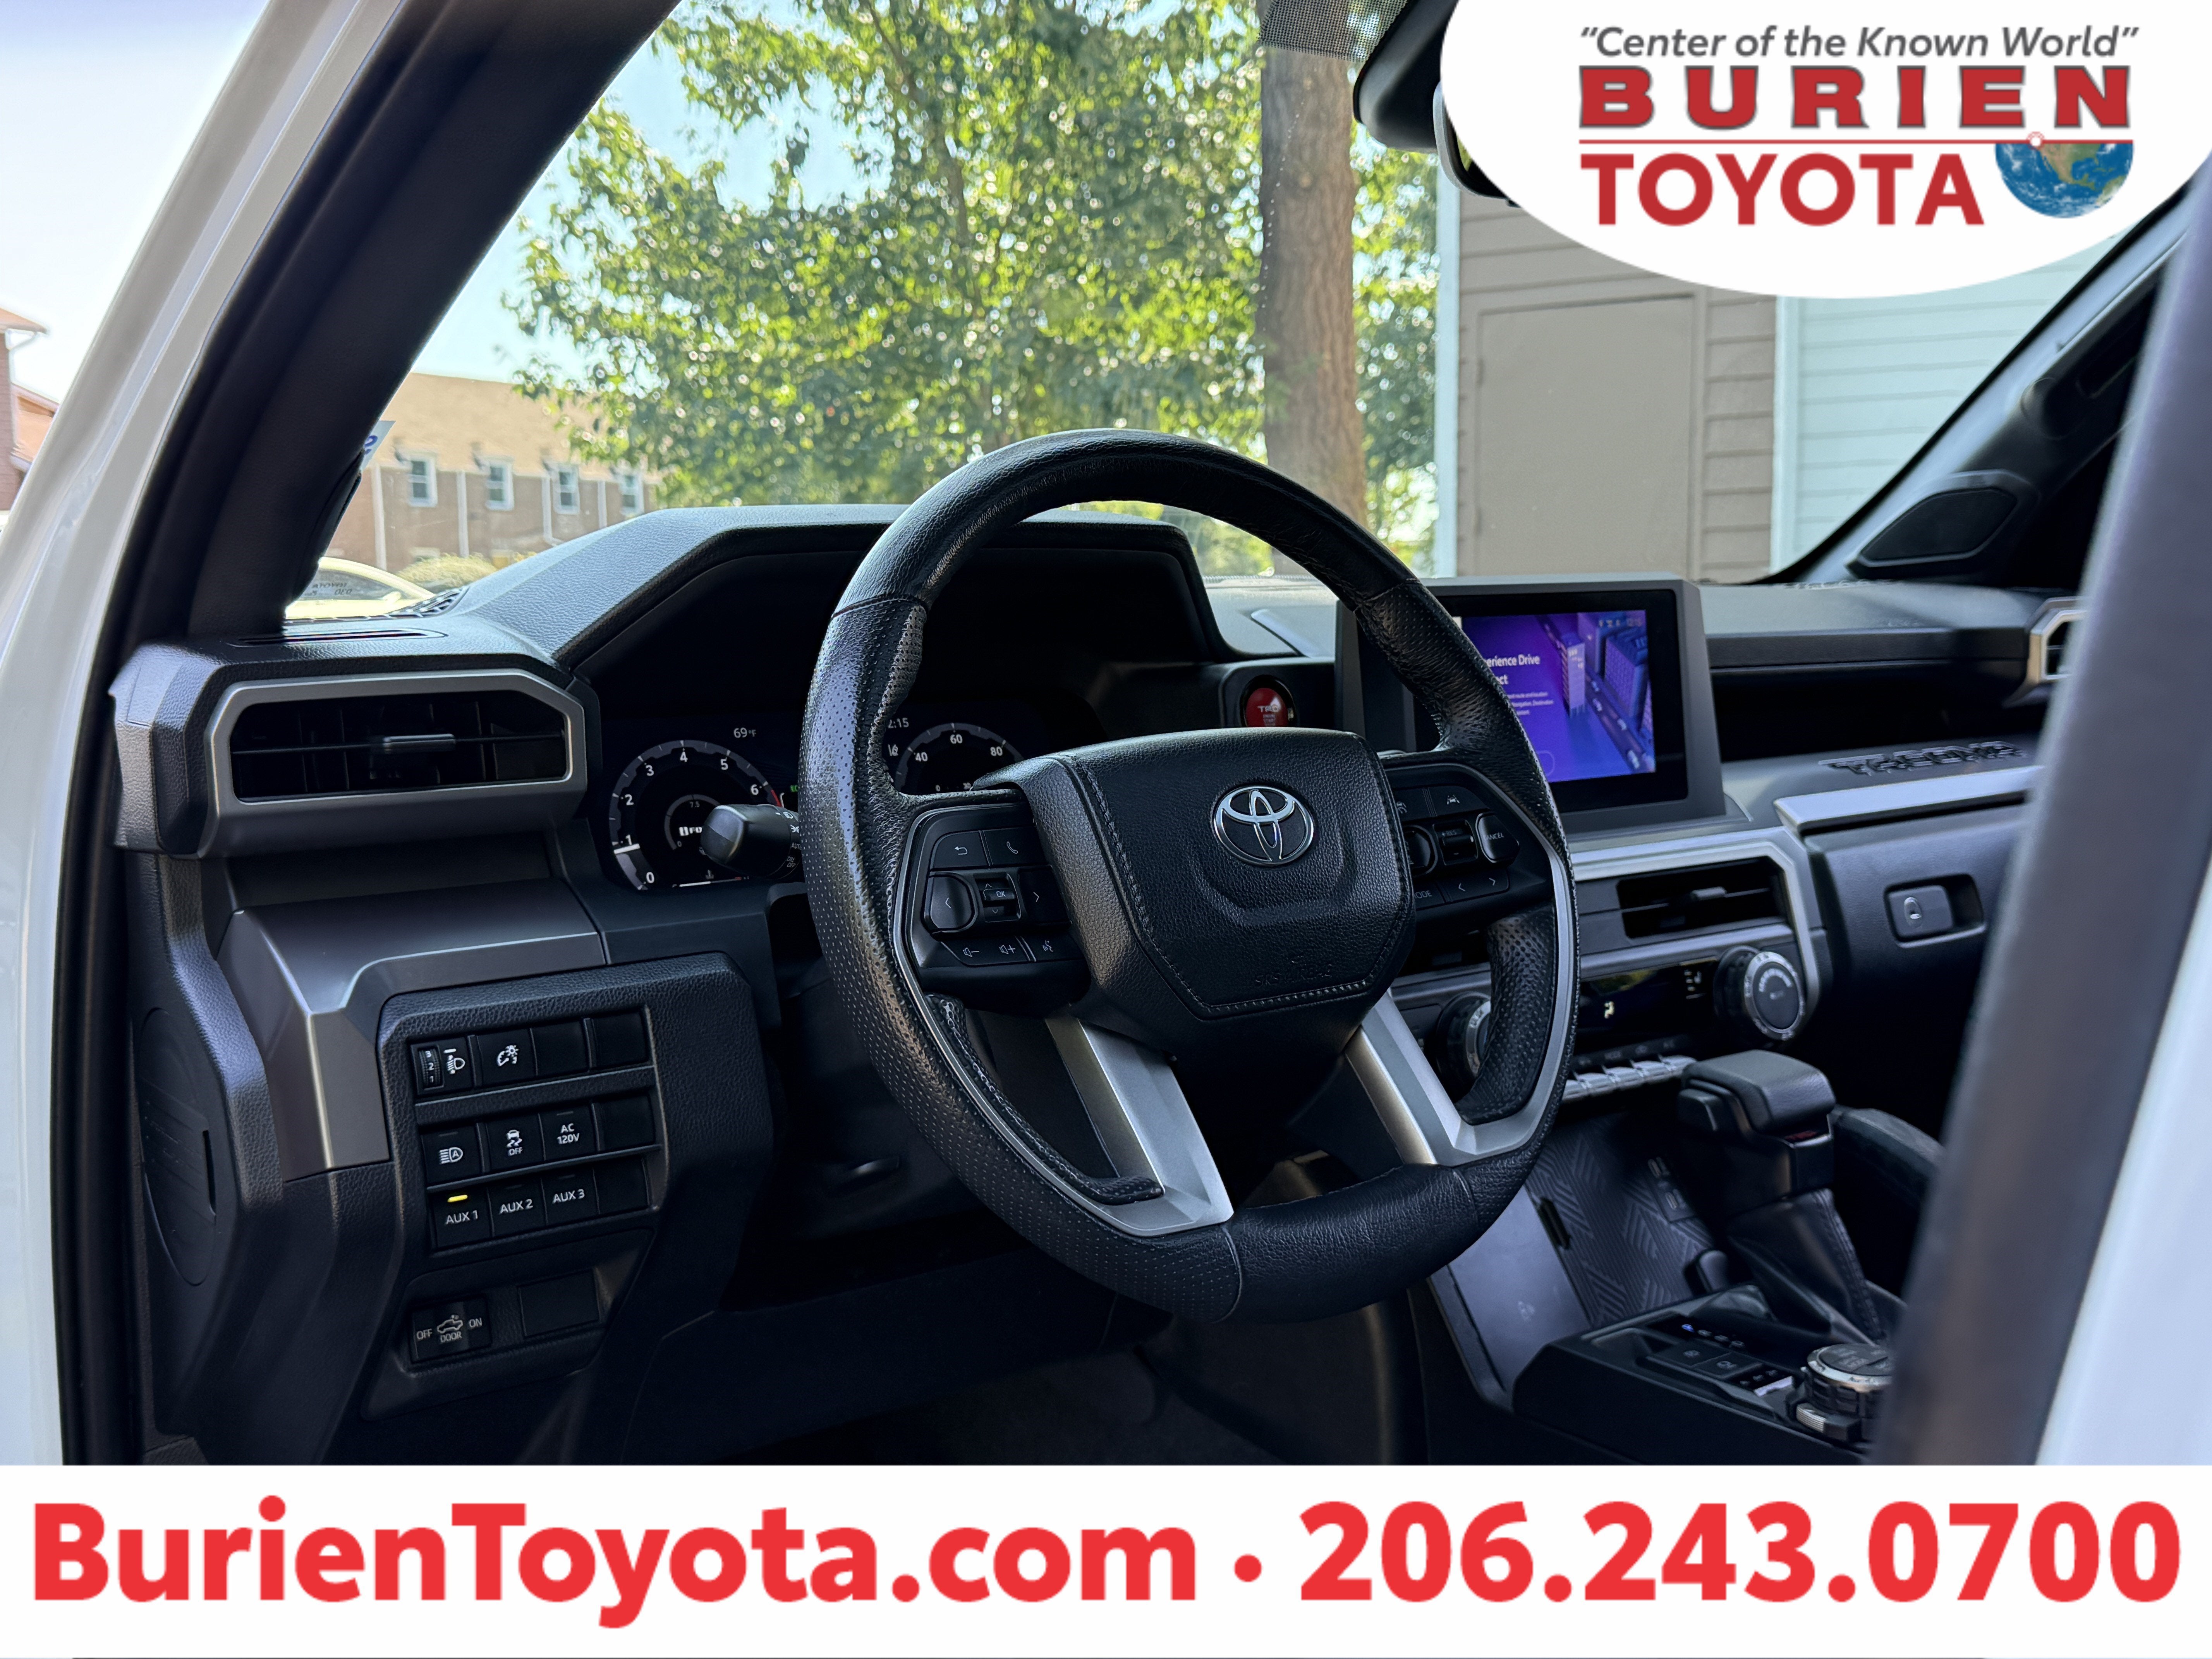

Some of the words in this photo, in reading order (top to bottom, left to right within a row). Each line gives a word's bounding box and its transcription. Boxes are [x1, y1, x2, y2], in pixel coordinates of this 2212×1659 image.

[1518, 654, 1540, 665] Drive
[950, 734, 963, 744] 60
[990, 746, 1003, 756] 80
[680, 751, 688, 763] 4
[915, 752, 928, 762] 40
[721, 759, 728, 770] 5
[646, 765, 654, 776] 3
[750, 784, 759, 795] 6
[625, 794, 634, 805] 2
[626, 836, 632, 845] 1
[646, 872, 654, 883] 0
[560, 1123, 575, 1133] AC
[557, 1133, 580, 1144] 120V
[509, 1147, 523, 1156] OFF
[552, 1190, 576, 1203] AUX
[577, 1189, 585, 1199] 3
[499, 1200, 523, 1214] AUX
[525, 1199, 533, 1210] 2
[445, 1212, 470, 1225] AUX
[473, 1210, 478, 1220] 1
[469, 1317, 483, 1328] ON
[416, 1329, 433, 1340] OFF
[440, 1331, 462, 1343] DOOR
